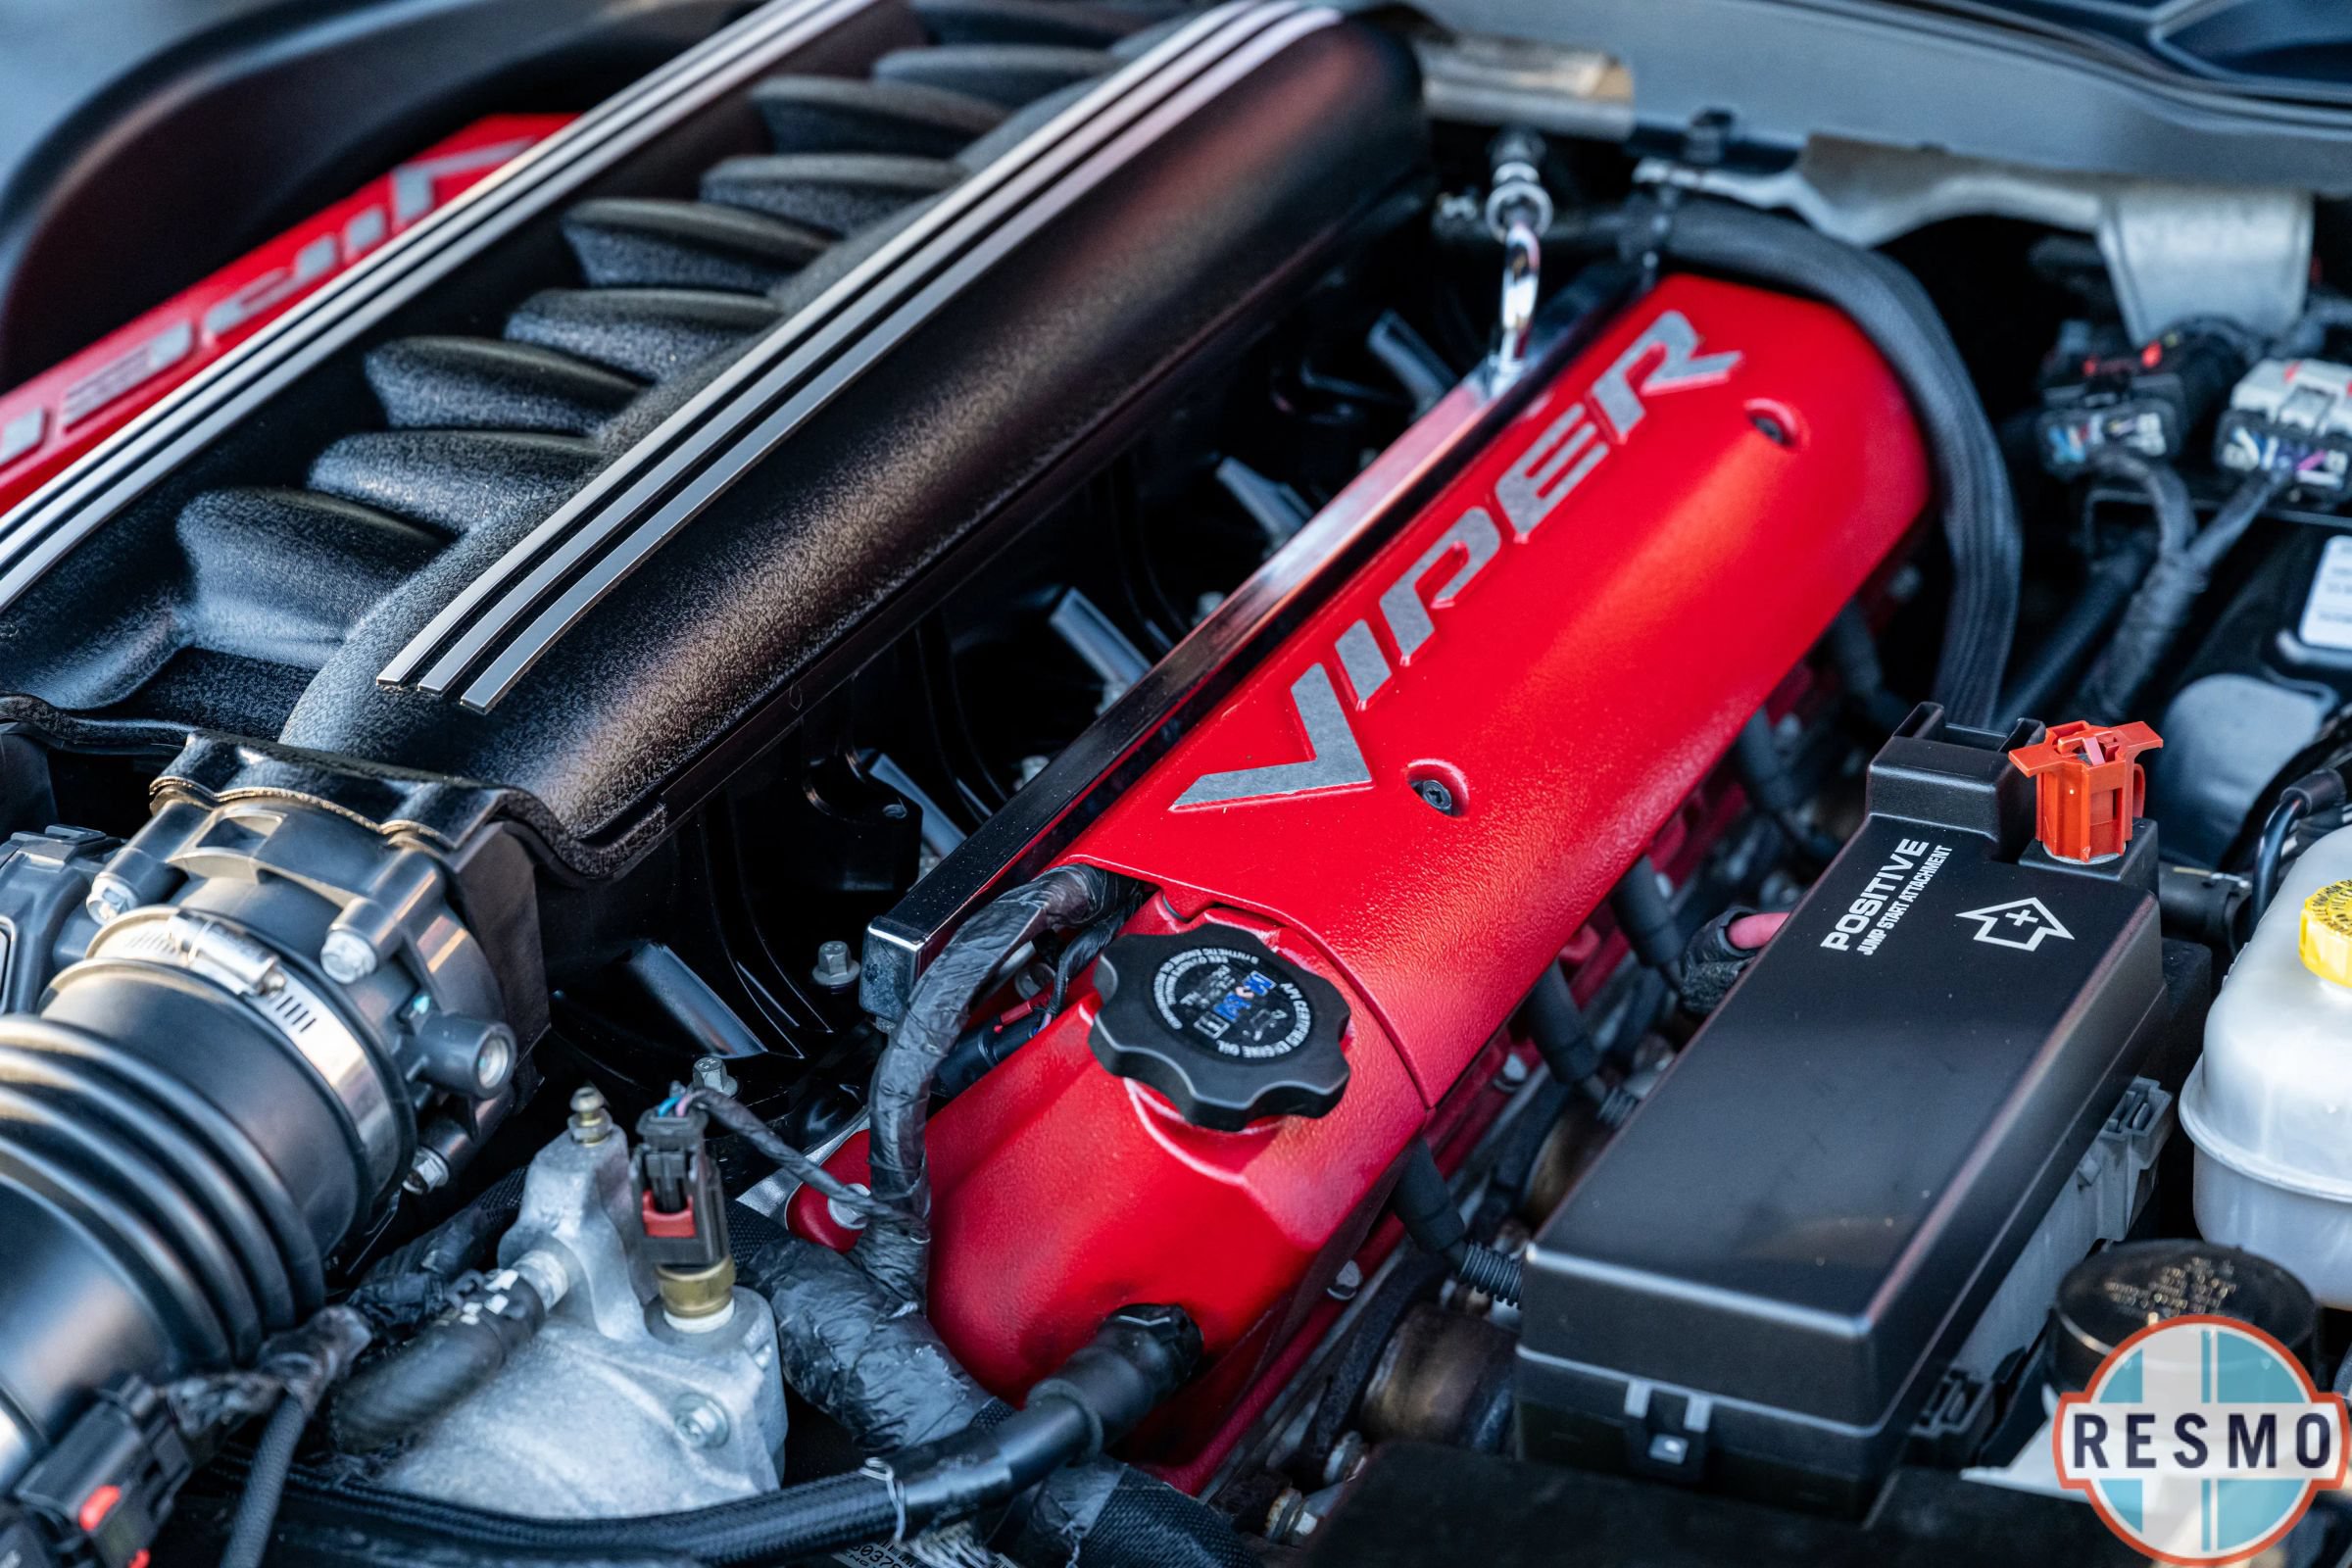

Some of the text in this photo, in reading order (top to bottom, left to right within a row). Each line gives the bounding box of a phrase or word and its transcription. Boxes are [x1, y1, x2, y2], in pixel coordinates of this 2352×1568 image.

[0, 136, 541, 466] VIPE
[1170, 311, 1741, 810] VIPER
[1820, 839, 1930, 951] POSITIVE
[1856, 845, 1952, 956] JUMP START ATTACHMENT
[1279, 983, 1302, 1000] API
